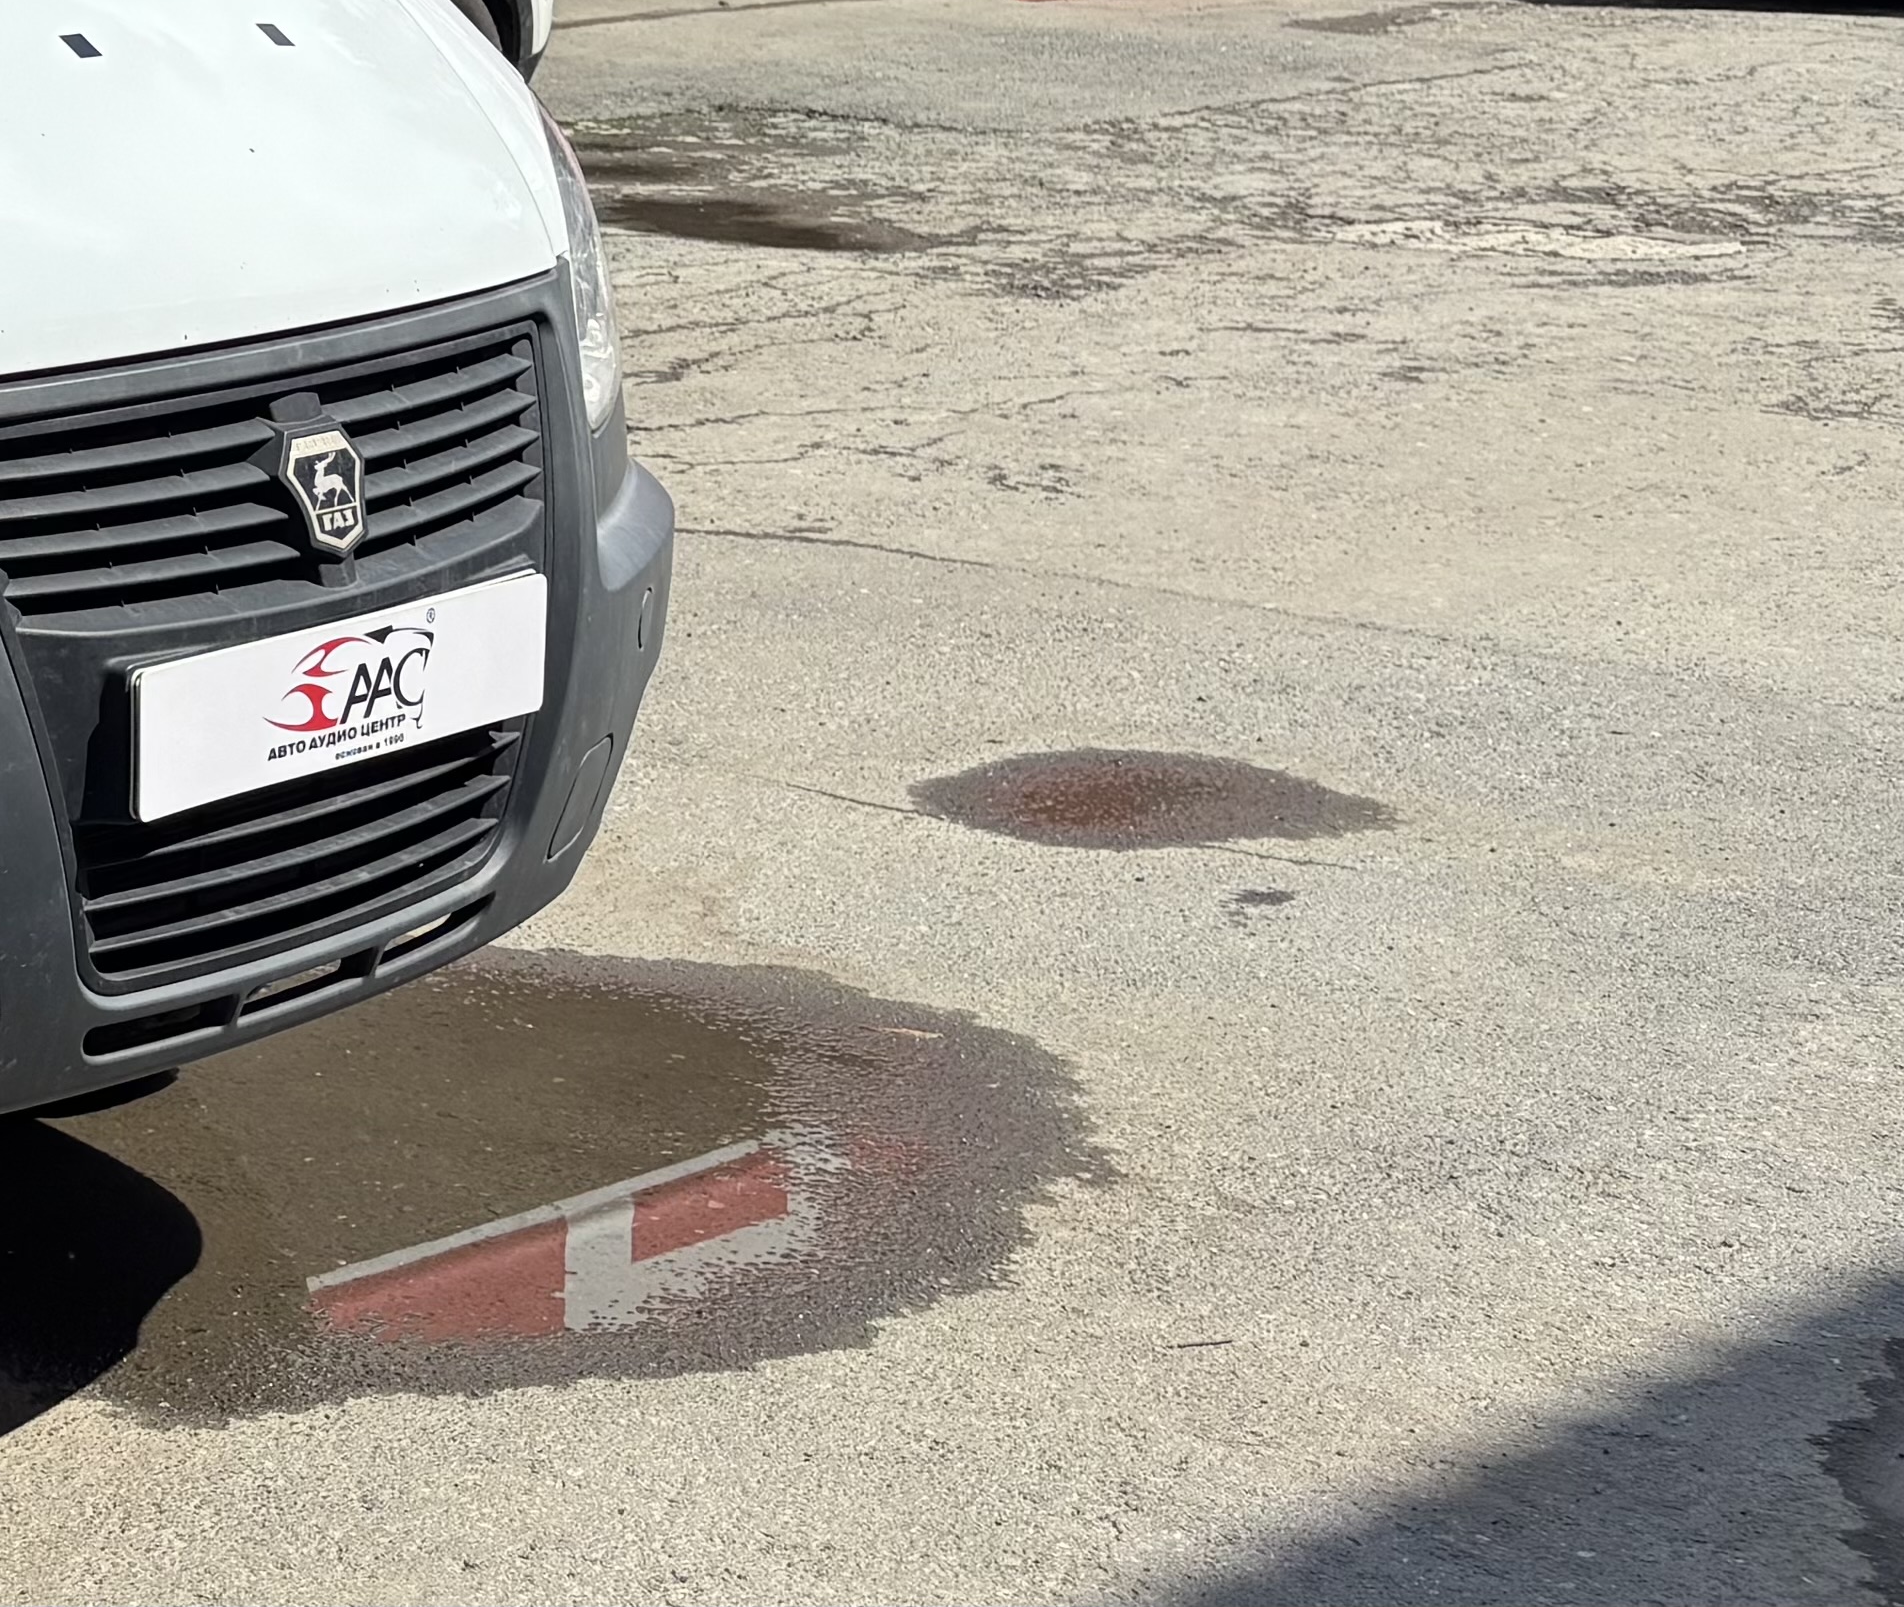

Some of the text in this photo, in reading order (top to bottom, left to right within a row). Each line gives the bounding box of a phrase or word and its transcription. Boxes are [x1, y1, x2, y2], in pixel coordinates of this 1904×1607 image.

[321, 508, 355, 532] ГАЗ
[267, 713, 407, 762] АВТО АУДИО ЦЕНТР
